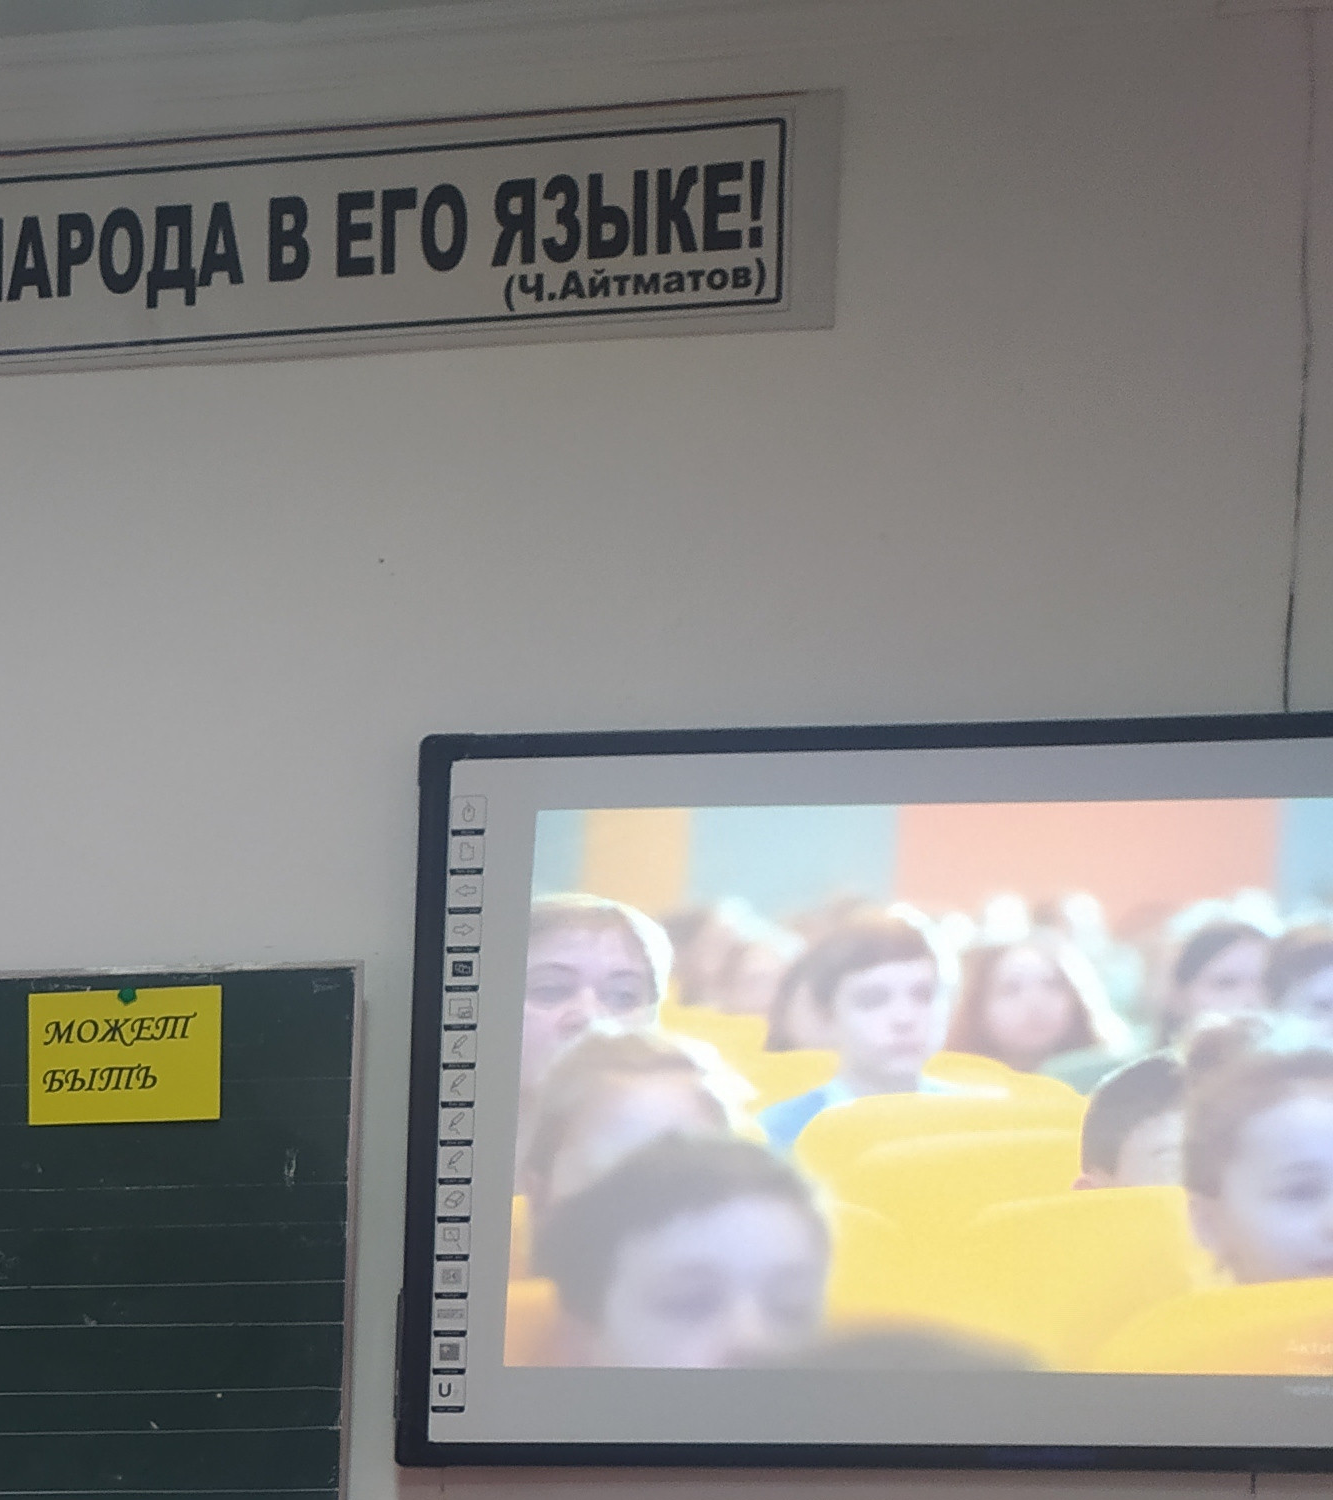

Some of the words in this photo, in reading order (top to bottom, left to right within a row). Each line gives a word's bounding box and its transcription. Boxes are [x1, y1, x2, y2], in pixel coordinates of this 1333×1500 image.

[268, 196, 310, 283] В
[336, 183, 469, 278] ЕГО
[491, 159, 766, 268] ЯЗЫКЕ!
[43, 1012, 198, 1047] МОЖЕТ
[42, 1063, 158, 1093] БЫТЬ
